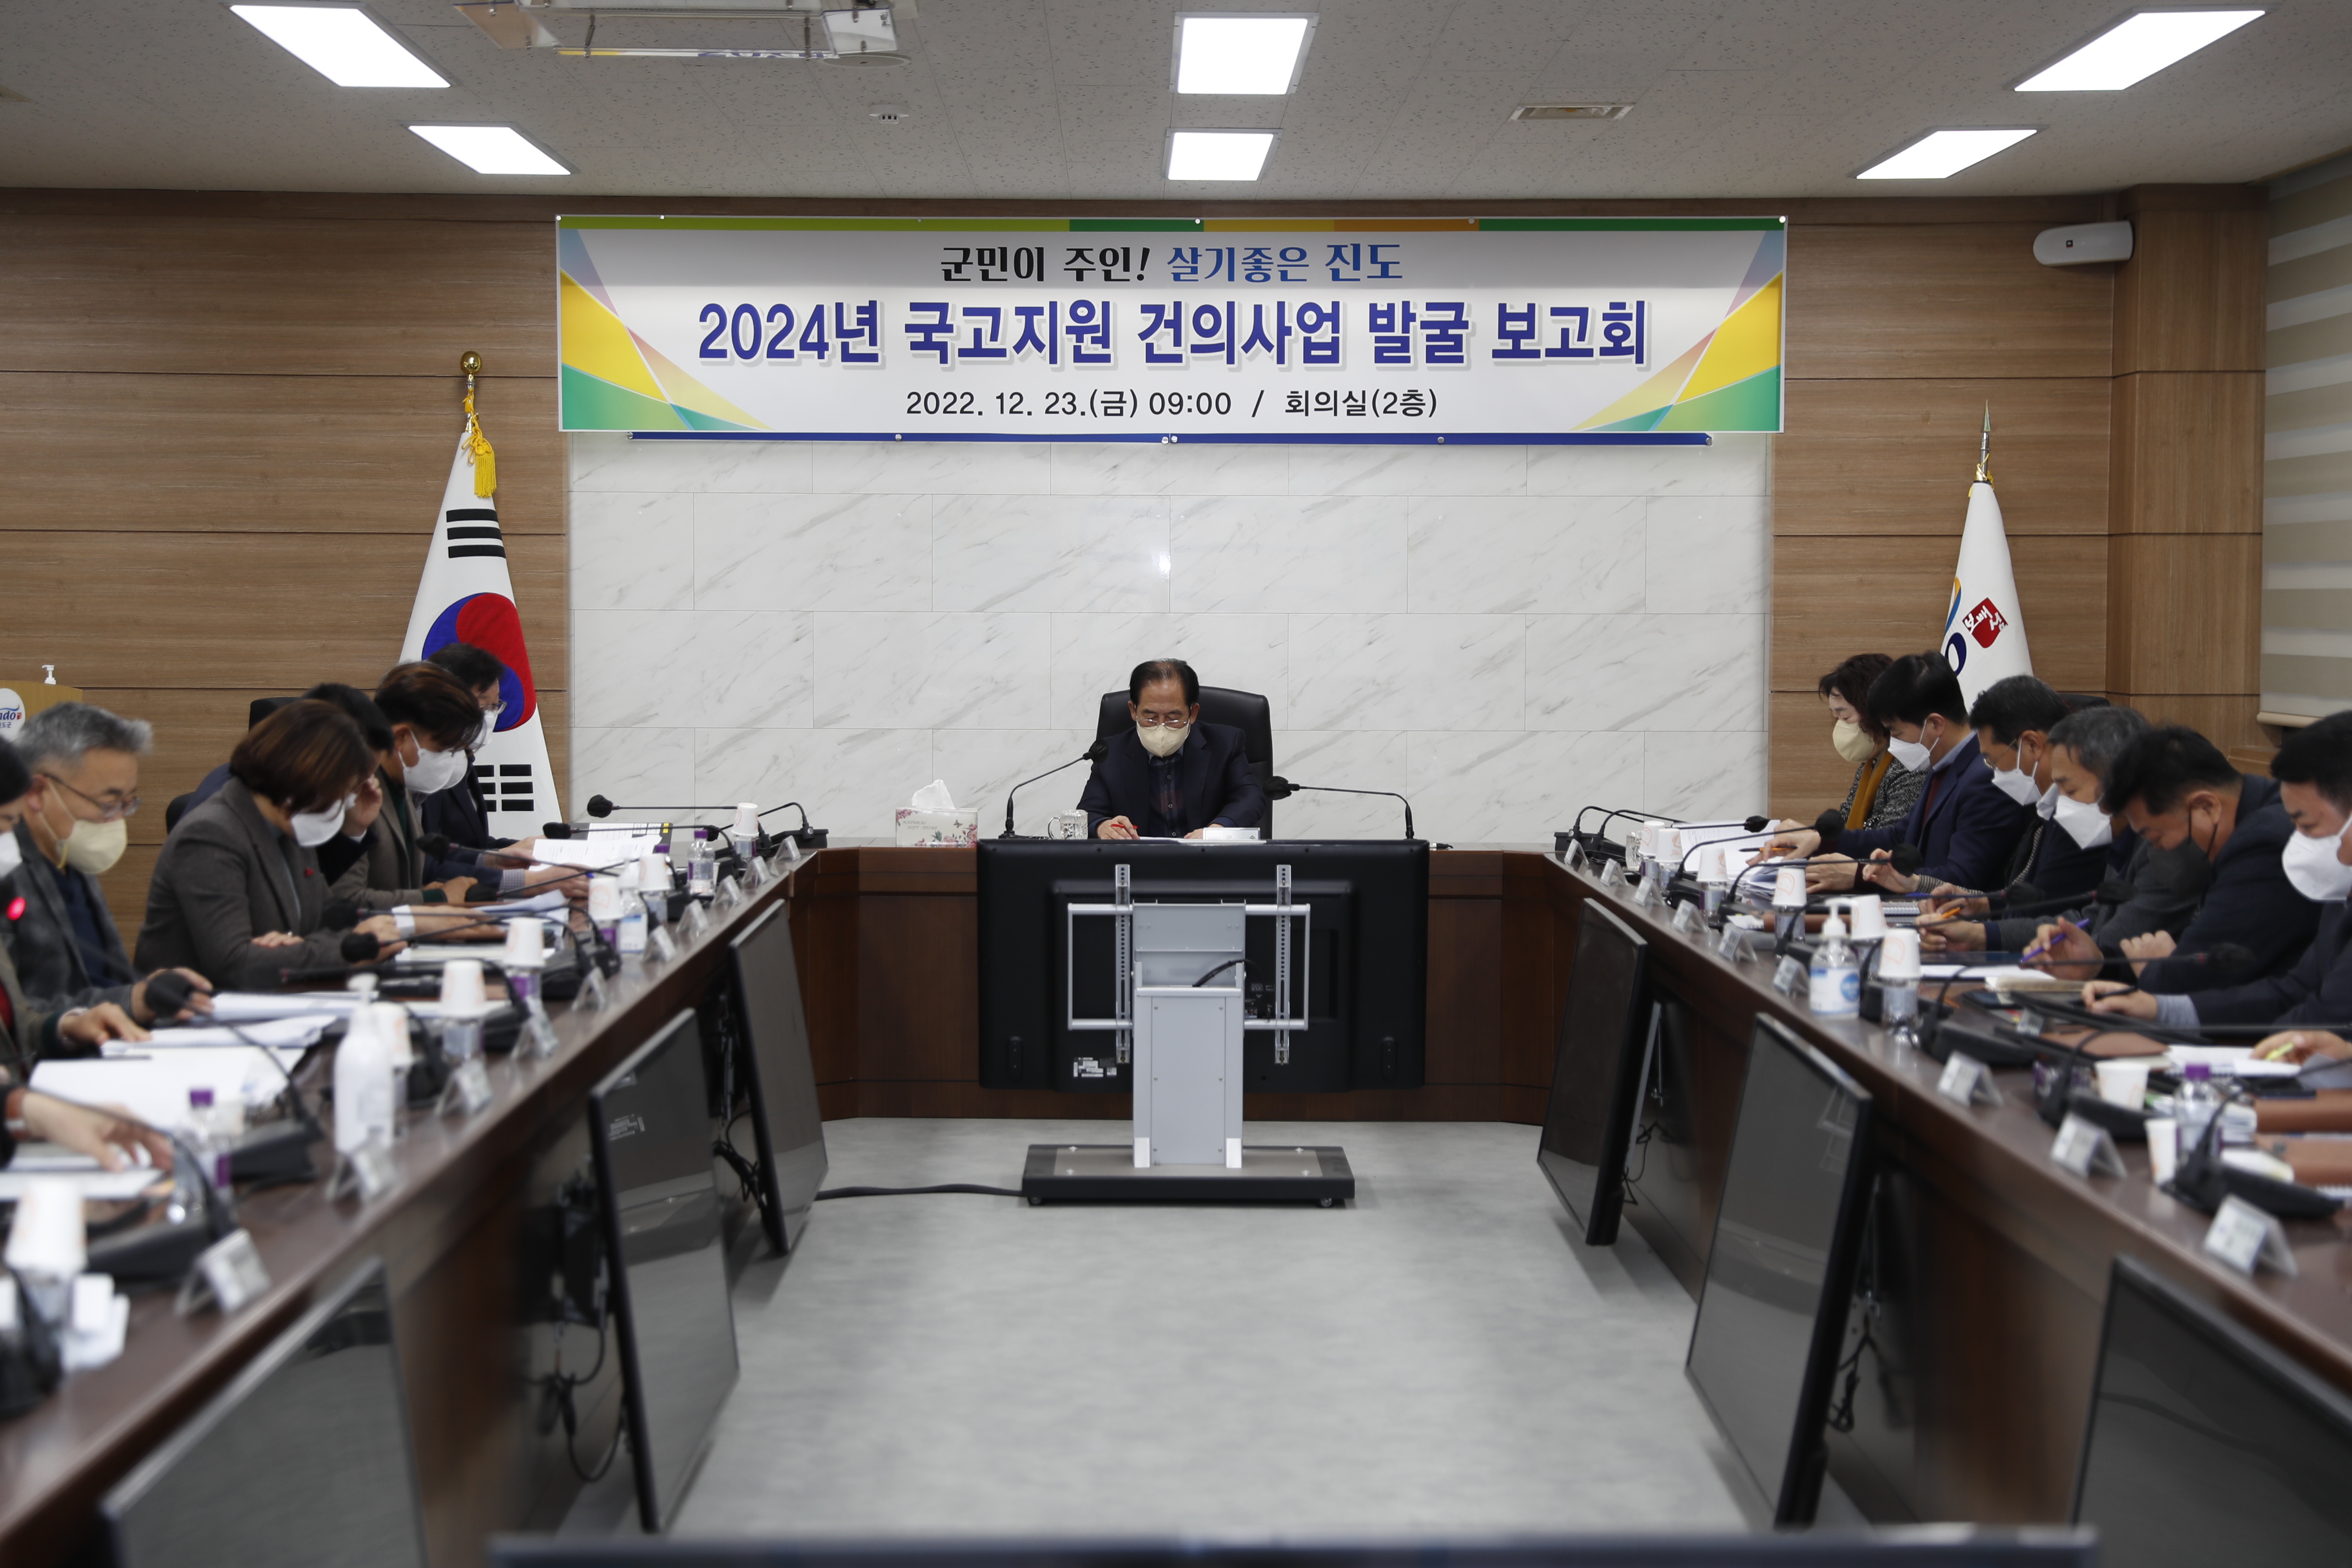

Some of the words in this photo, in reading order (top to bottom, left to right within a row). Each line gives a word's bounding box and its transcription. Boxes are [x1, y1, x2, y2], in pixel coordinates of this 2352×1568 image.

[941, 246, 1044, 282] 군민이
[1063, 246, 1150, 282] 주인!
[1166, 246, 1310, 283] 살기좋은
[1325, 243, 1404, 282] 진도
[699, 299, 879, 364] 2024년
[904, 299, 1112, 366] 국고지원
[1137, 300, 1340, 366] 건의사업
[1369, 300, 1469, 364] 발굴
[1491, 300, 1645, 365] 보고회
[906, 391, 983, 416] 2022.
[995, 391, 1033, 416] 12.
[1044, 389, 1138, 418] 23.(금)
[1149, 391, 1232, 416] 09:00
[1251, 389, 1265, 418] /
[1285, 388, 1437, 418] 회의실(2층)
